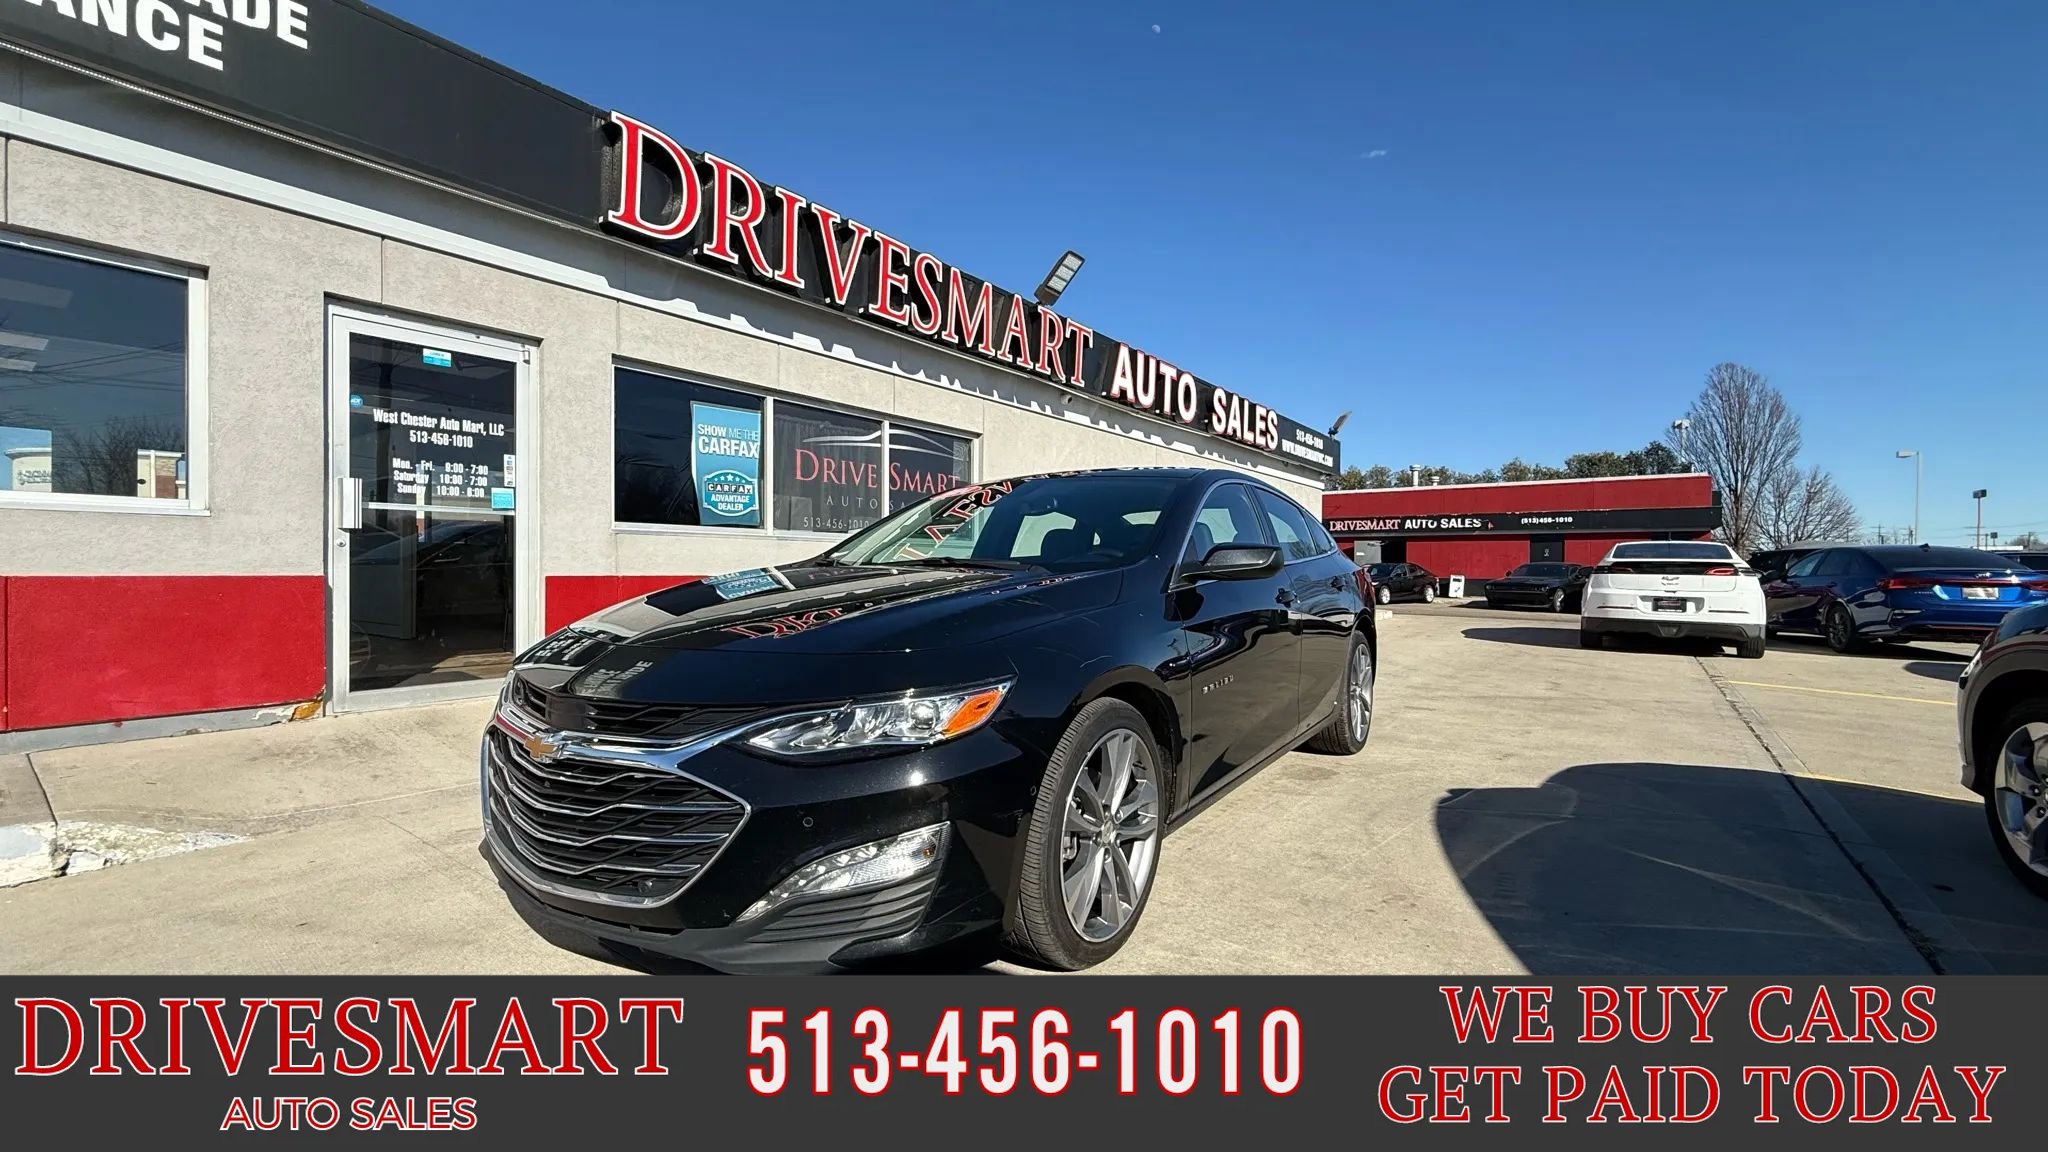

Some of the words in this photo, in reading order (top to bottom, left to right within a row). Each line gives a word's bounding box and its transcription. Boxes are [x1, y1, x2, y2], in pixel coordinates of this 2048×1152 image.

[183, 0, 309, 50] DE
[23, 0, 224, 71] NCE
[608, 110, 1093, 388] DRIVESMART
[1110, 342, 1198, 424] AUTO
[1211, 387, 1279, 452] SALES
[373, 408, 398, 425] West
[400, 411, 438, 429] Chester
[440, 416, 460, 432] Auto
[462, 419, 487, 436] Mart,
[488, 422, 505, 437] LLC
[697, 423, 727, 438] SHOW
[728, 427, 742, 440] ME
[743, 428, 760, 442] THE
[698, 435, 760, 459] CARFAX
[392, 457, 414, 470] Mon.
[420, 459, 436, 472] Fri.
[470, 464, 489, 476] 7:00
[794, 448, 879, 489] DRIVE
[889, 461, 961, 495] SMART
[393, 469, 430, 485] Saturday
[439, 473, 464, 486] 10:00
[470, 475, 488, 487] 7:00
[397, 482, 427, 496] Sunday
[436, 485, 461, 497] 10:00
[708, 483, 752, 495] CARFAX
[711, 493, 750, 503] ADVANTAGE
[718, 502, 744, 511] DEALER
[826, 495, 878, 510] AUTO
[1329, 518, 1401, 531] DRIVESMART
[1404, 519, 1438, 529] AUTO
[1440, 518, 1482, 529] SALES
